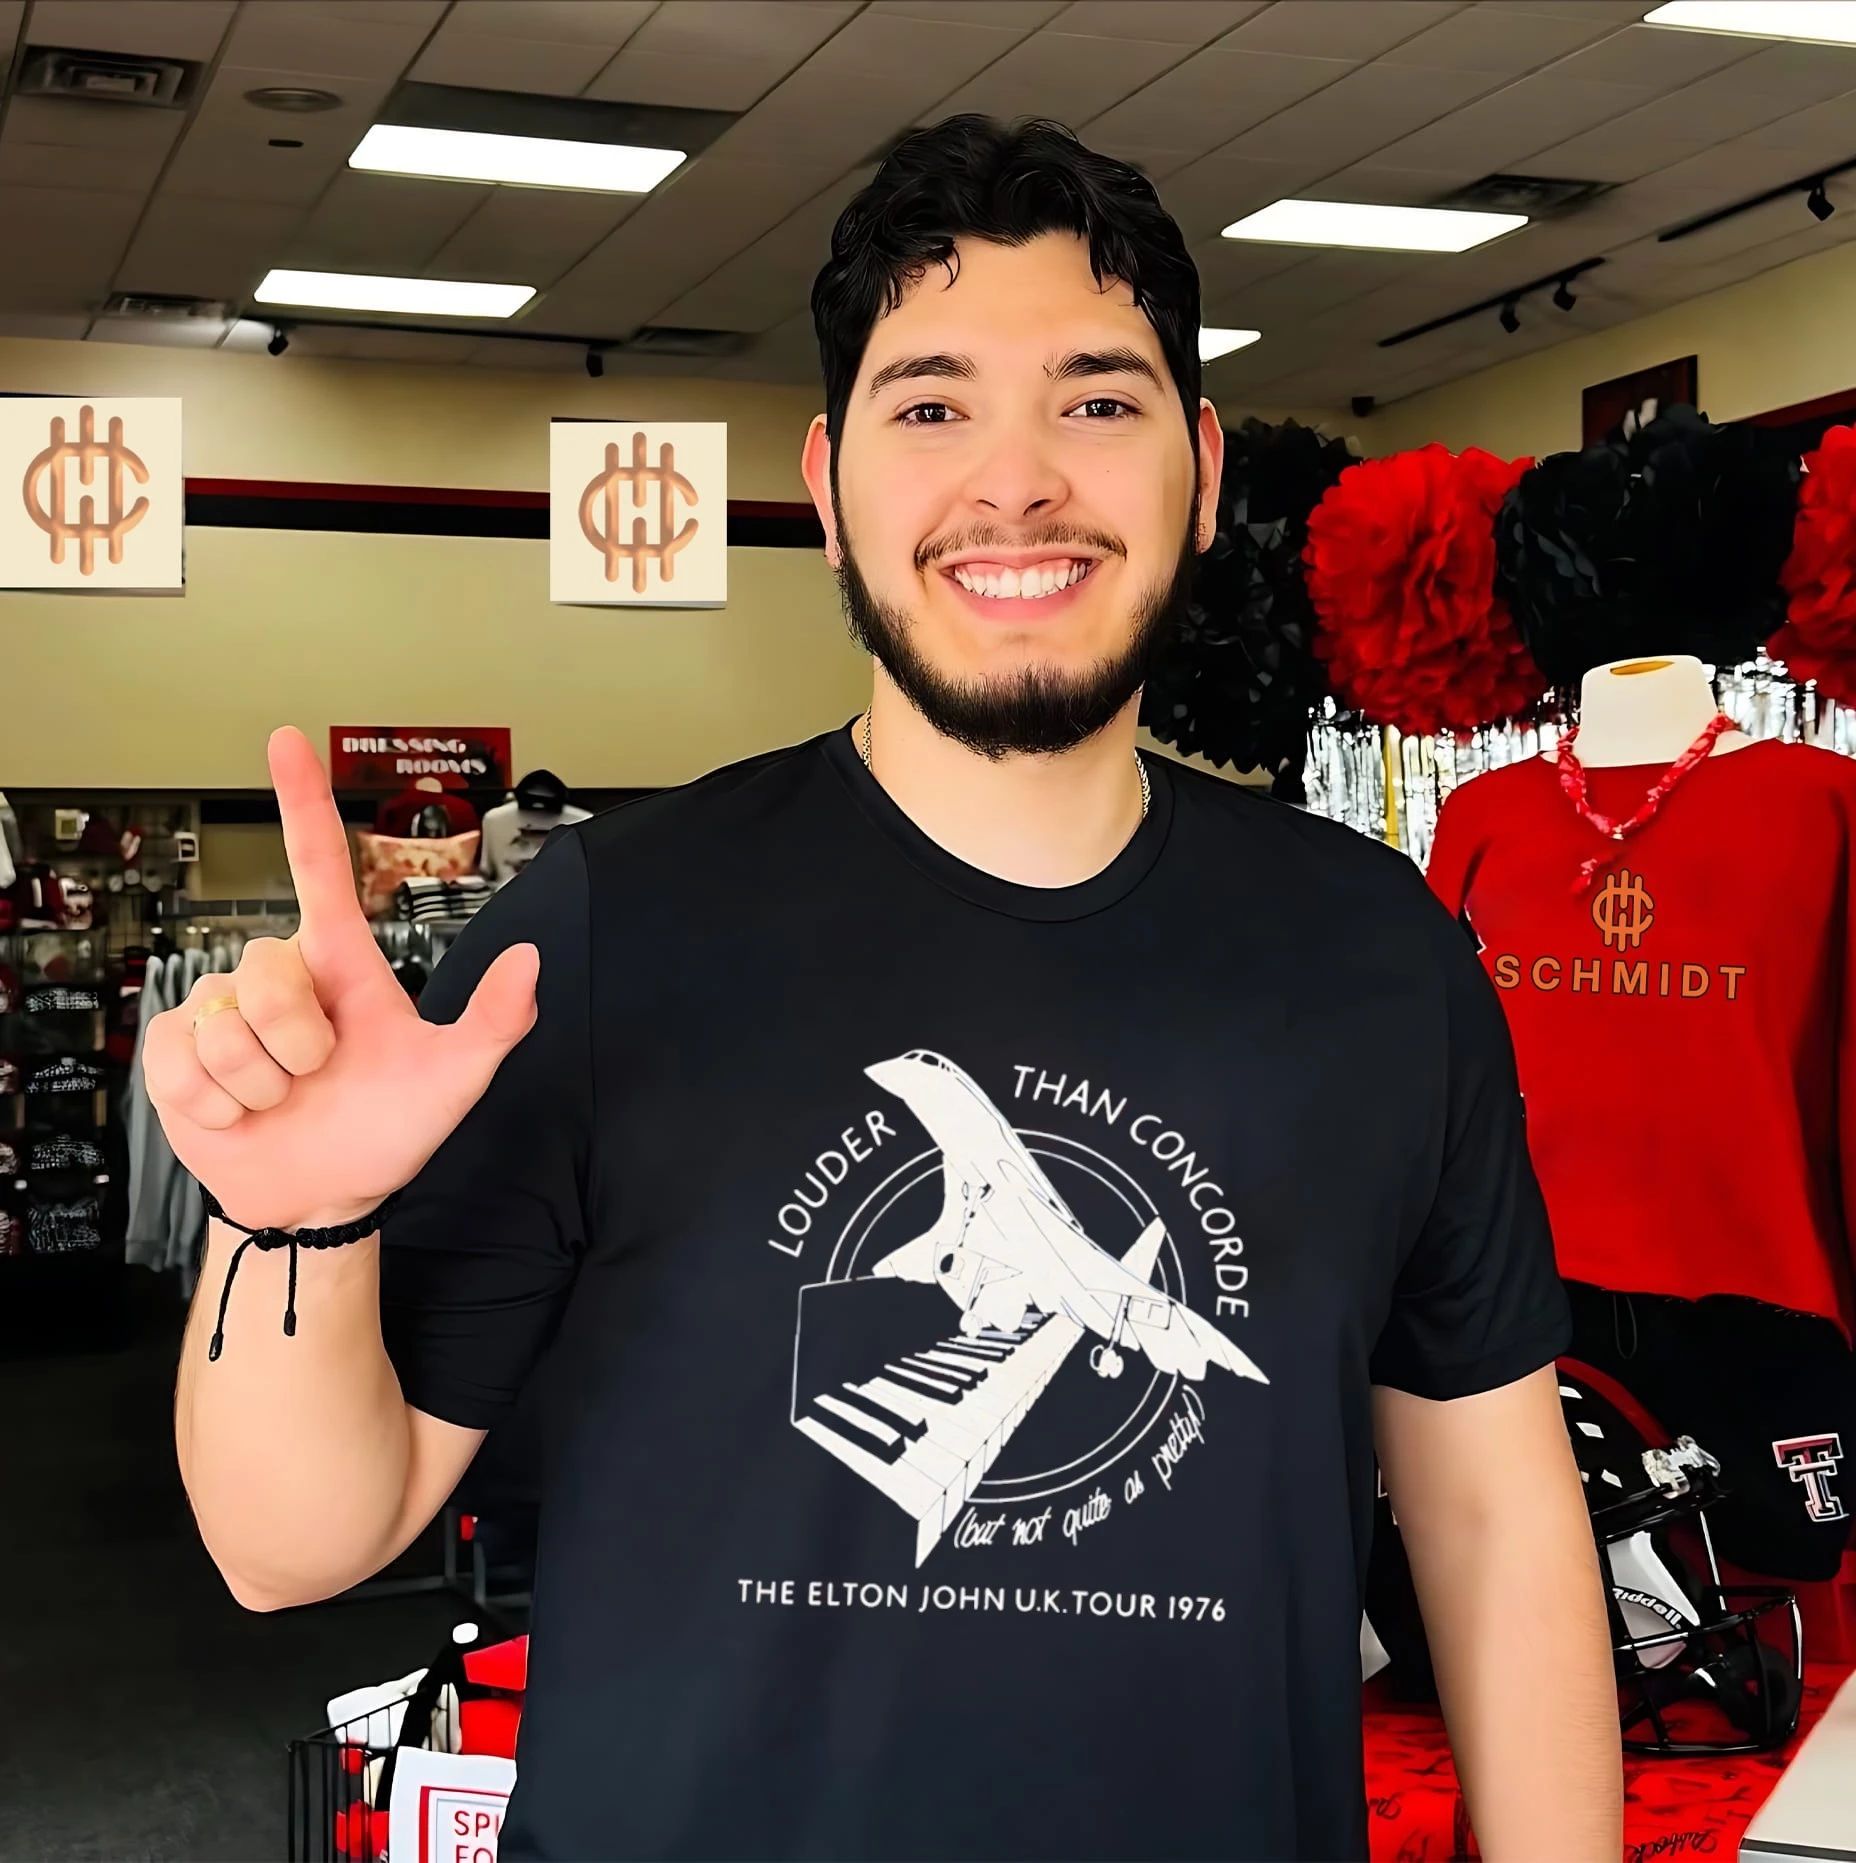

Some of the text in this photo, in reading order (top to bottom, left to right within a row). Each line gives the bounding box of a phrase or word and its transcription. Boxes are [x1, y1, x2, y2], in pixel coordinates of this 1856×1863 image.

[396, 758, 487, 775] ROOMS
[1494, 954, 1747, 1000] SCHMIDT
[767, 1065, 1249, 1318] LOUDER THAN CONCORDE
[953, 1506, 1006, 1549] (but
[1012, 1506, 1052, 1546] not
[1063, 1486, 1113, 1546] quite
[1124, 1469, 1145, 1505] as
[737, 1578, 795, 1605] THE
[808, 1581, 908, 1608] ELTON
[918, 1585, 1005, 1613] JOHN
[1071, 1590, 1157, 1619] TOUR
[1168, 1595, 1226, 1622] 1976
